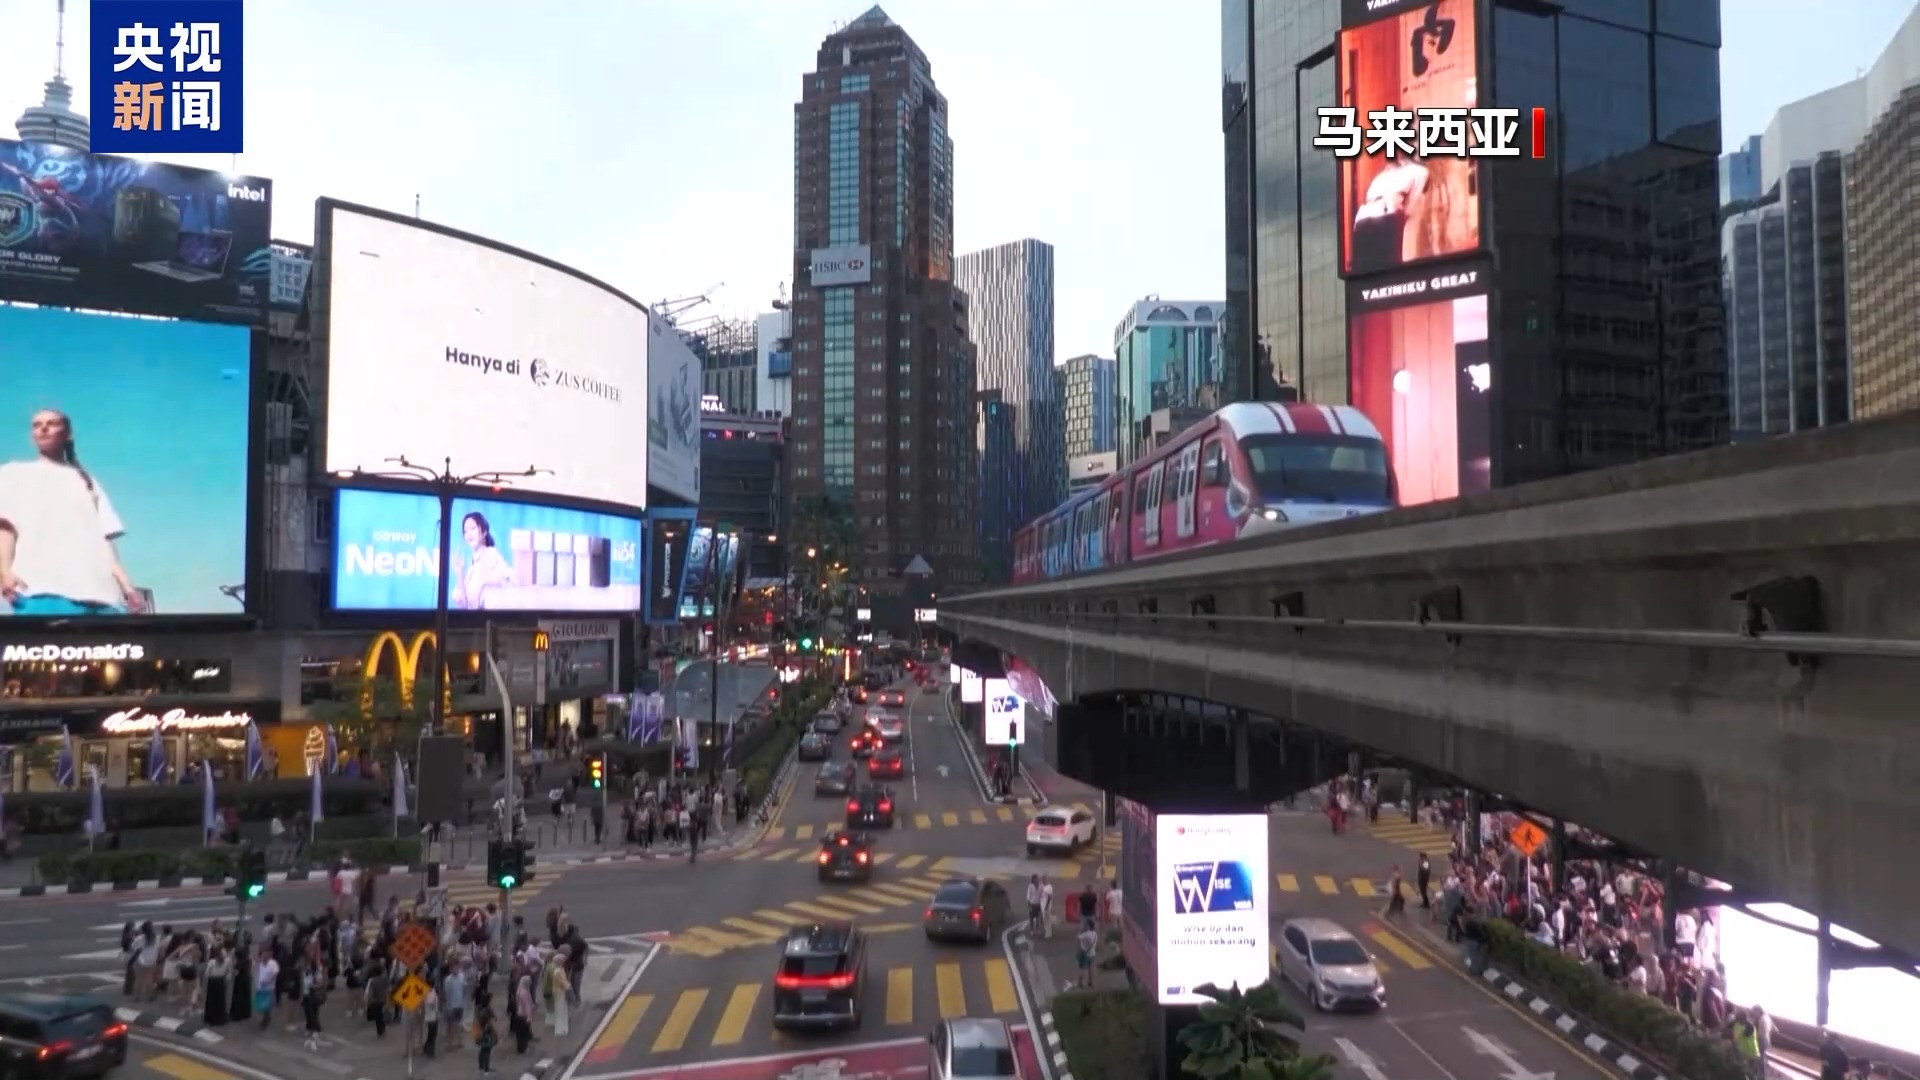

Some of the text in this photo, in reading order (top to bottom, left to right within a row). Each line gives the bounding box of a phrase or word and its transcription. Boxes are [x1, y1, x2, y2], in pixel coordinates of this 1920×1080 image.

[228, 183, 265, 202] intel
[18, 251, 61, 263] GLORY
[814, 261, 846, 273] HSBC
[1361, 271, 1478, 301] YAKINIKU GREAT
[446, 346, 502, 375] Hanya
[506, 359, 520, 375] di
[555, 369, 580, 391] ZUS
[3, 643, 144, 661] McDonald's
[1225, 924, 1244, 933] dan
[1209, 937, 1256, 947] sekarang
